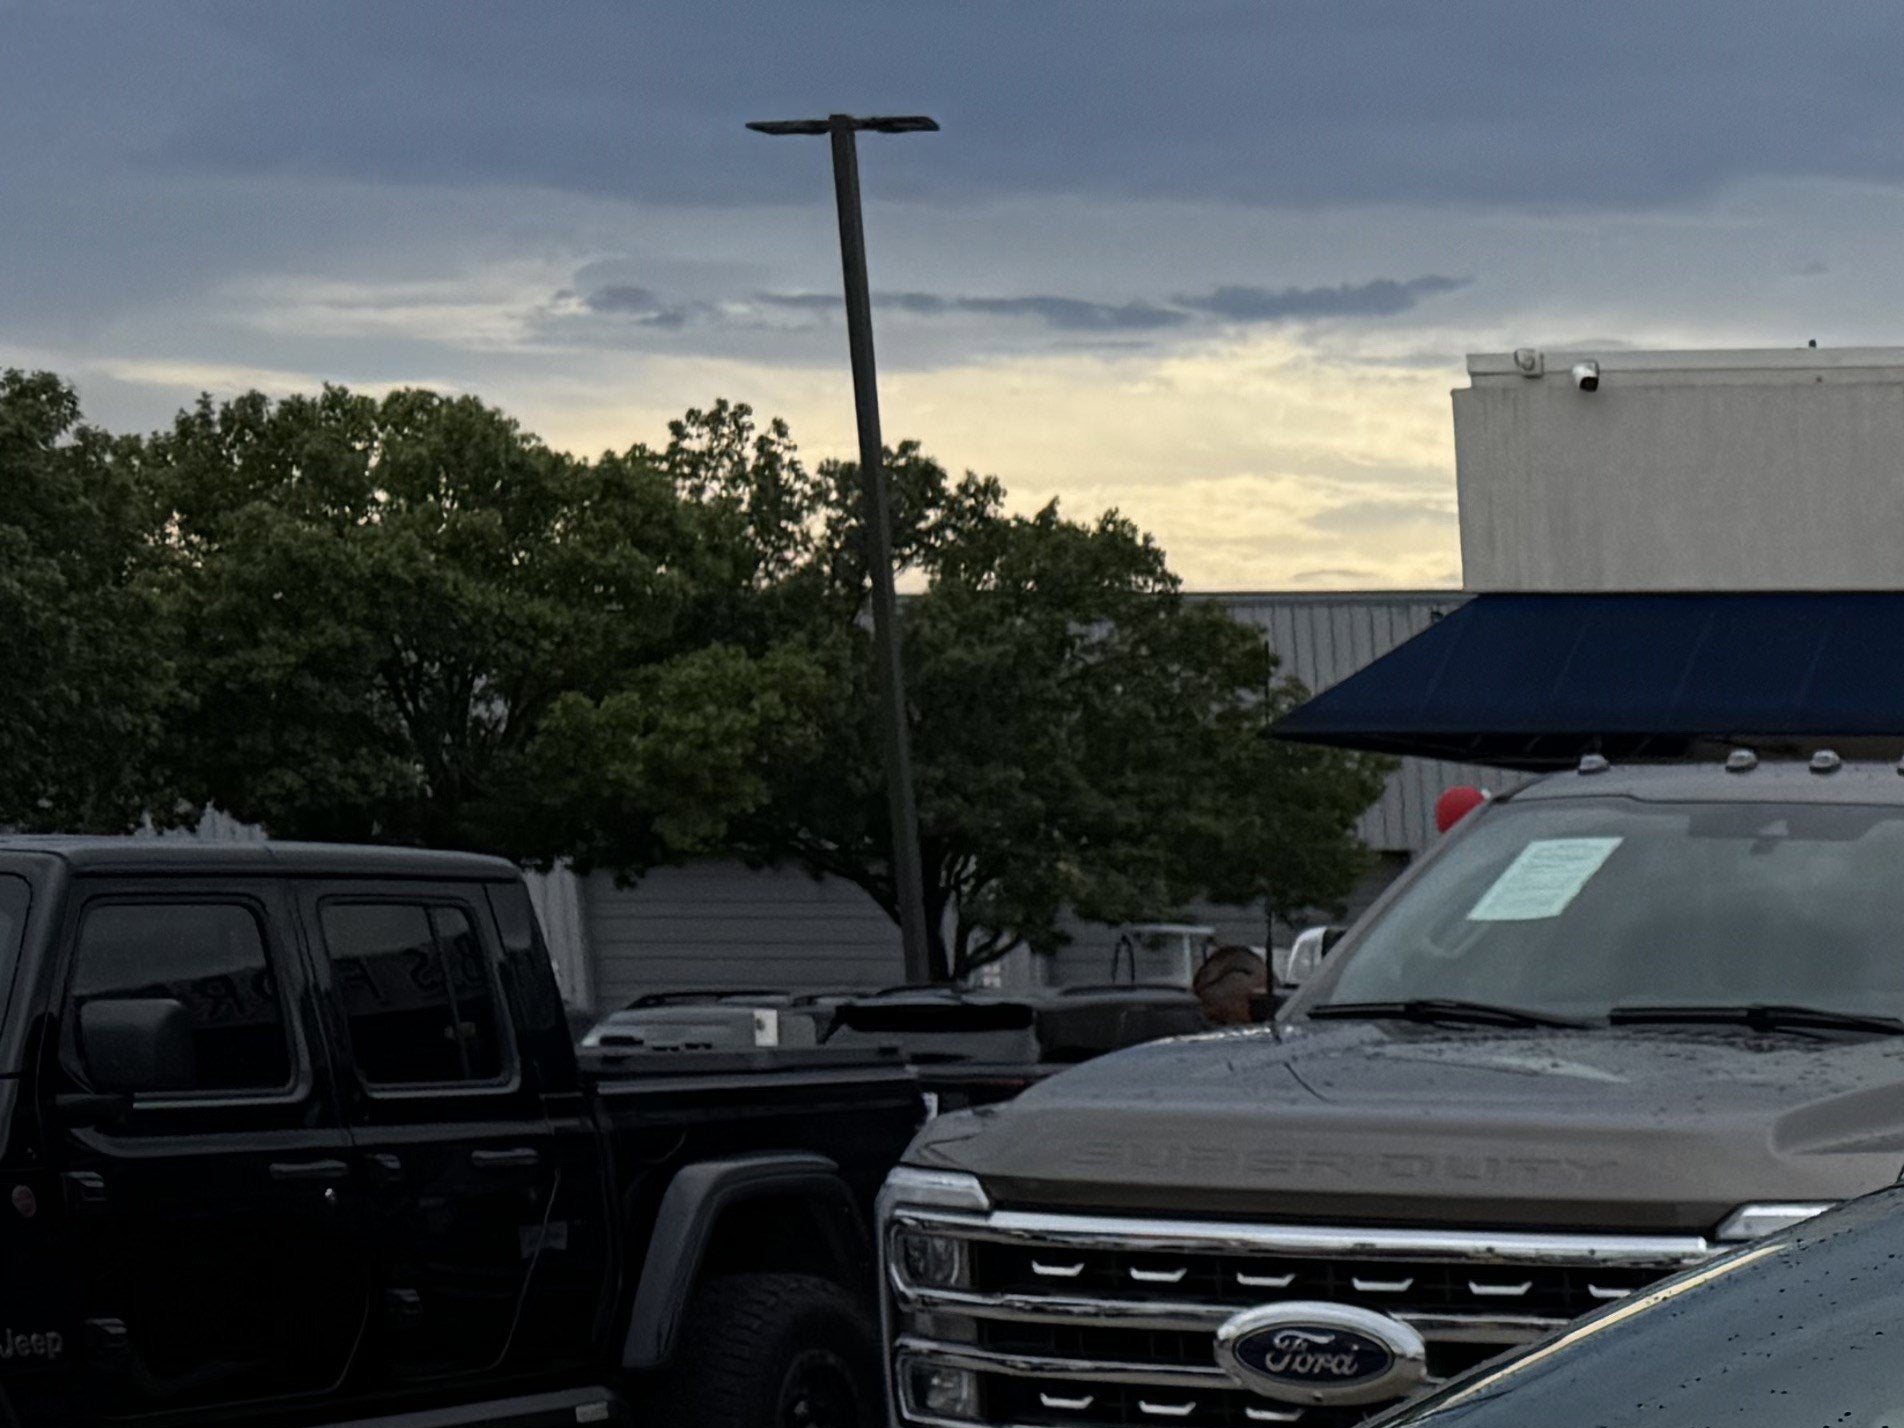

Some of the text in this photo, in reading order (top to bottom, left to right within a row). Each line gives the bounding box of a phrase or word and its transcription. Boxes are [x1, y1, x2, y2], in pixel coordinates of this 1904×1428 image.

[1074, 1141, 1621, 1185] SUPER DUTY
[0, 1327, 64, 1361] Jeep
[1264, 1329, 1360, 1376] Ford
